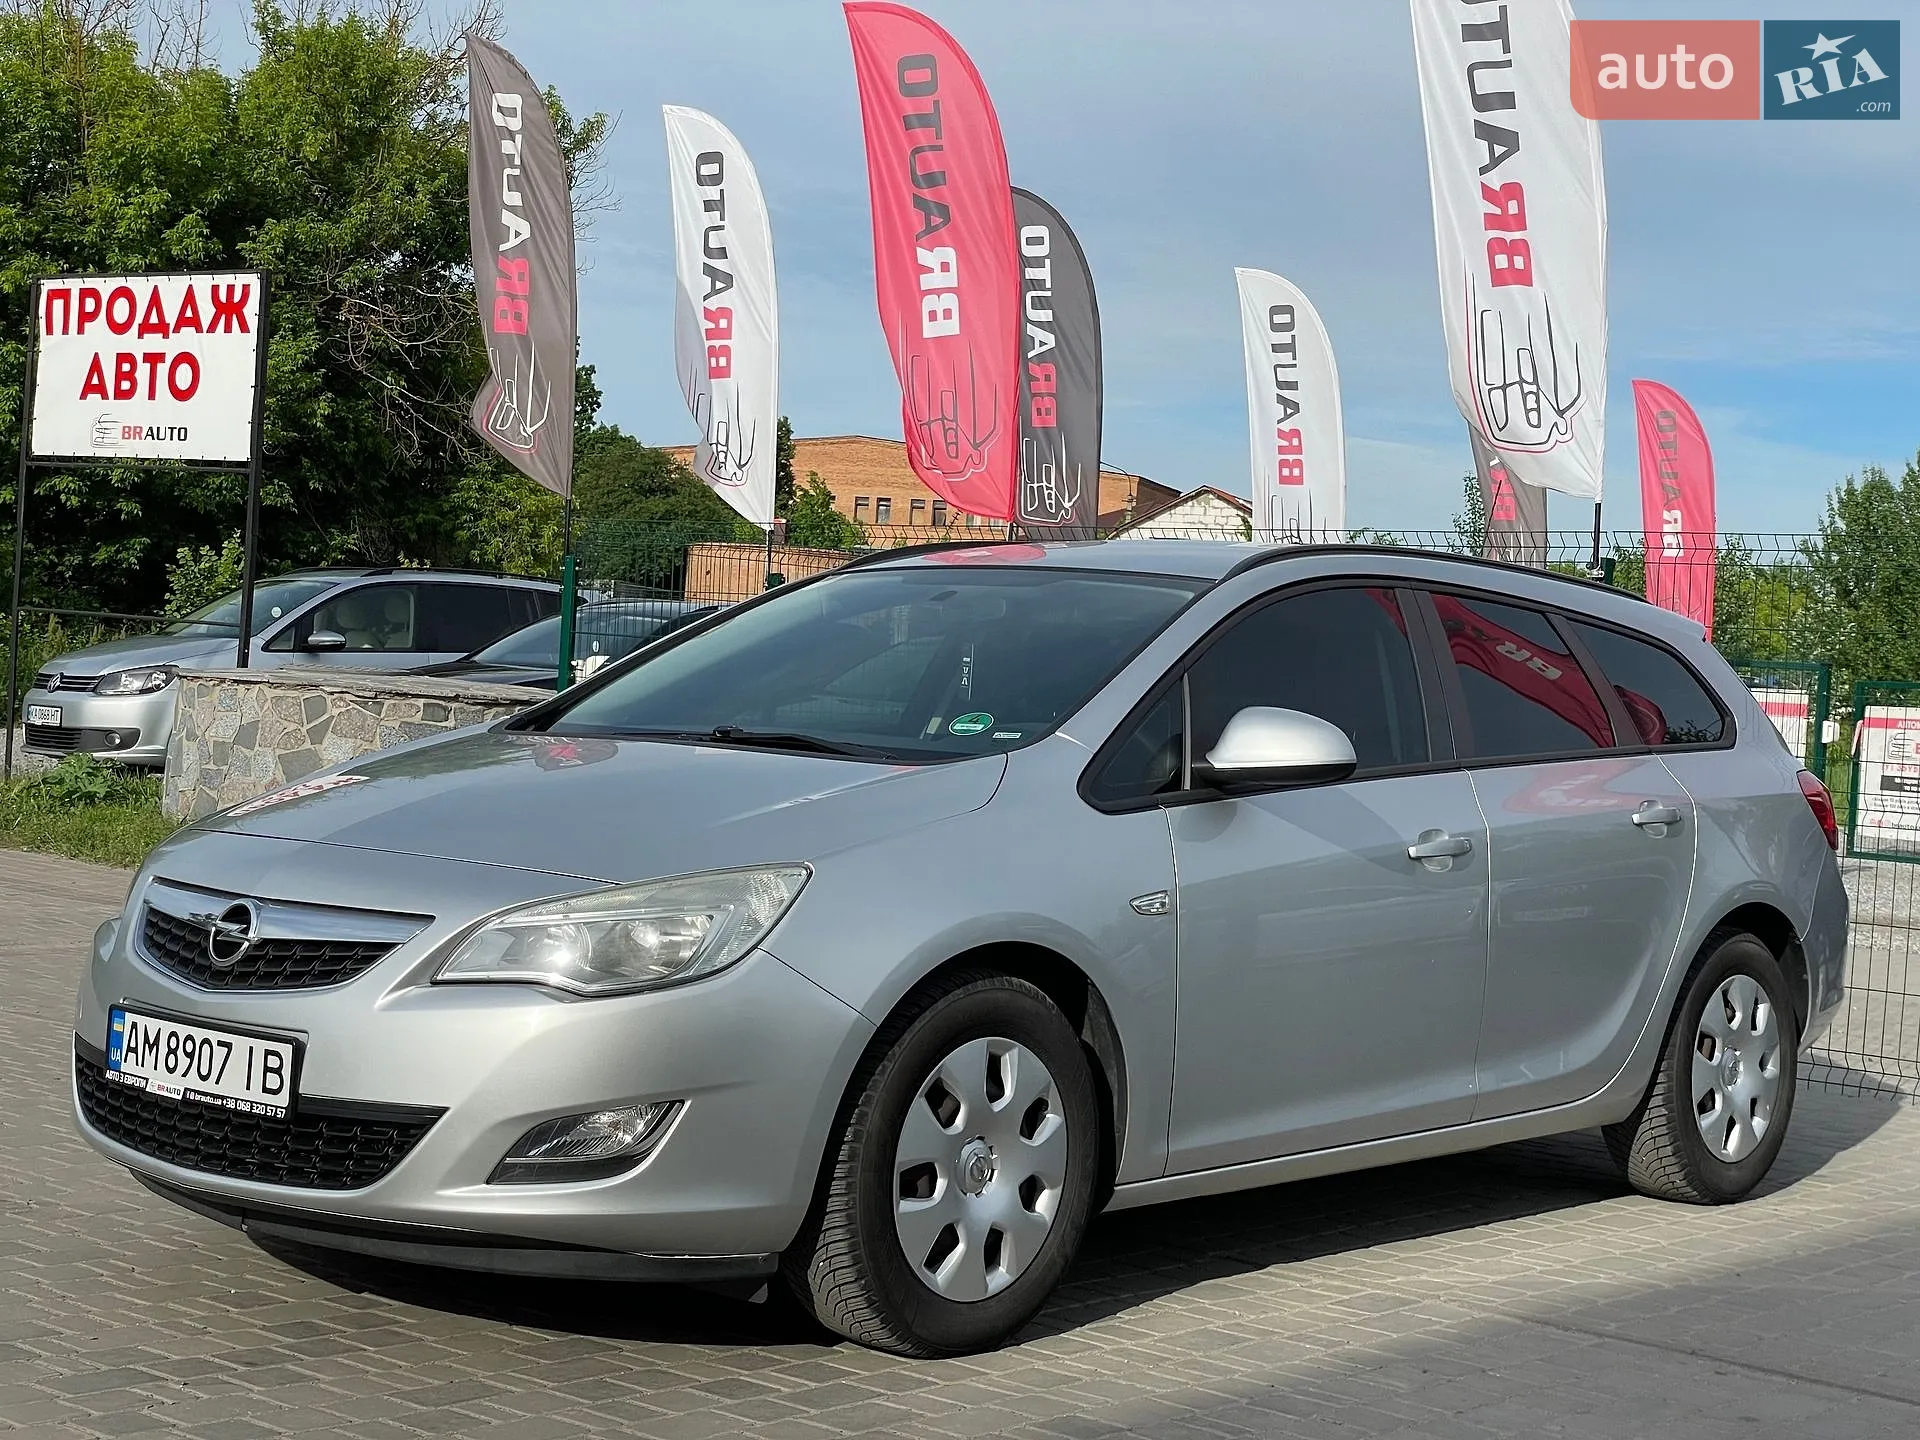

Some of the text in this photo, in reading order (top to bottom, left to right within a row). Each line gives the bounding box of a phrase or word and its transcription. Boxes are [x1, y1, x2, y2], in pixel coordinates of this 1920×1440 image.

[44, 283, 251, 339] ПРОДАЖ
[79, 351, 201, 402] АВТО
[121, 425, 188, 442] BRAUTO
[111, 1047, 122, 1062] UA
[164, 1030, 234, 1085] 8907
